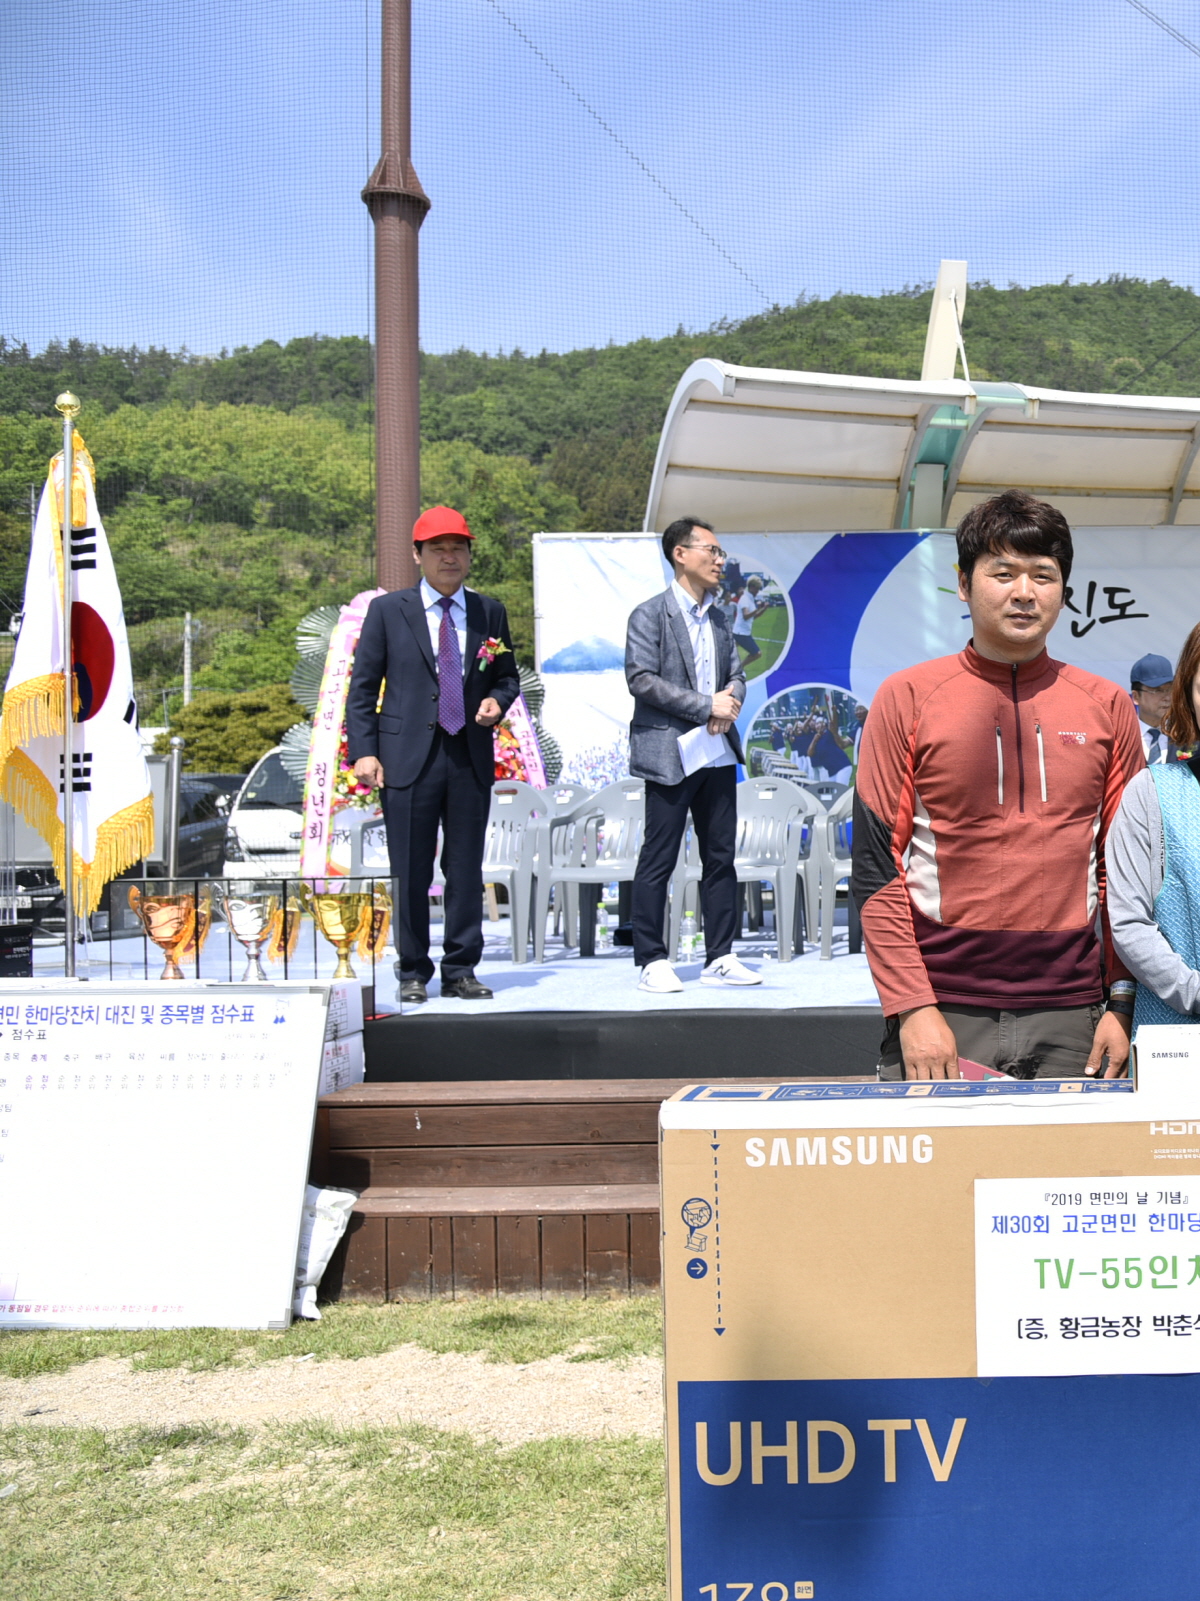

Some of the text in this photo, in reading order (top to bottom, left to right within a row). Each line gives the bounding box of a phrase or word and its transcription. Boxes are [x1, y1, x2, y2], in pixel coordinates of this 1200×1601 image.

[25, 1005, 99, 1025] 한마당잔치
[105, 1005, 135, 1025] 대진
[141, 1005, 154, 1024] 및
[160, 1005, 205, 1025] 종목별
[211, 1004, 255, 1024] 점수표
[12, 1029, 47, 1040] 점수표
[745, 1134, 933, 1167] SAMSUNG
[1089, 1191, 1128, 1206] 면민의
[1136, 1191, 1148, 1205] 날
[991, 1214, 1049, 1234] 제30회
[1062, 1213, 1136, 1233] 고군면민
[1059, 1316, 1142, 1340] 황금농장
[695, 1418, 967, 1485] UHD TV
